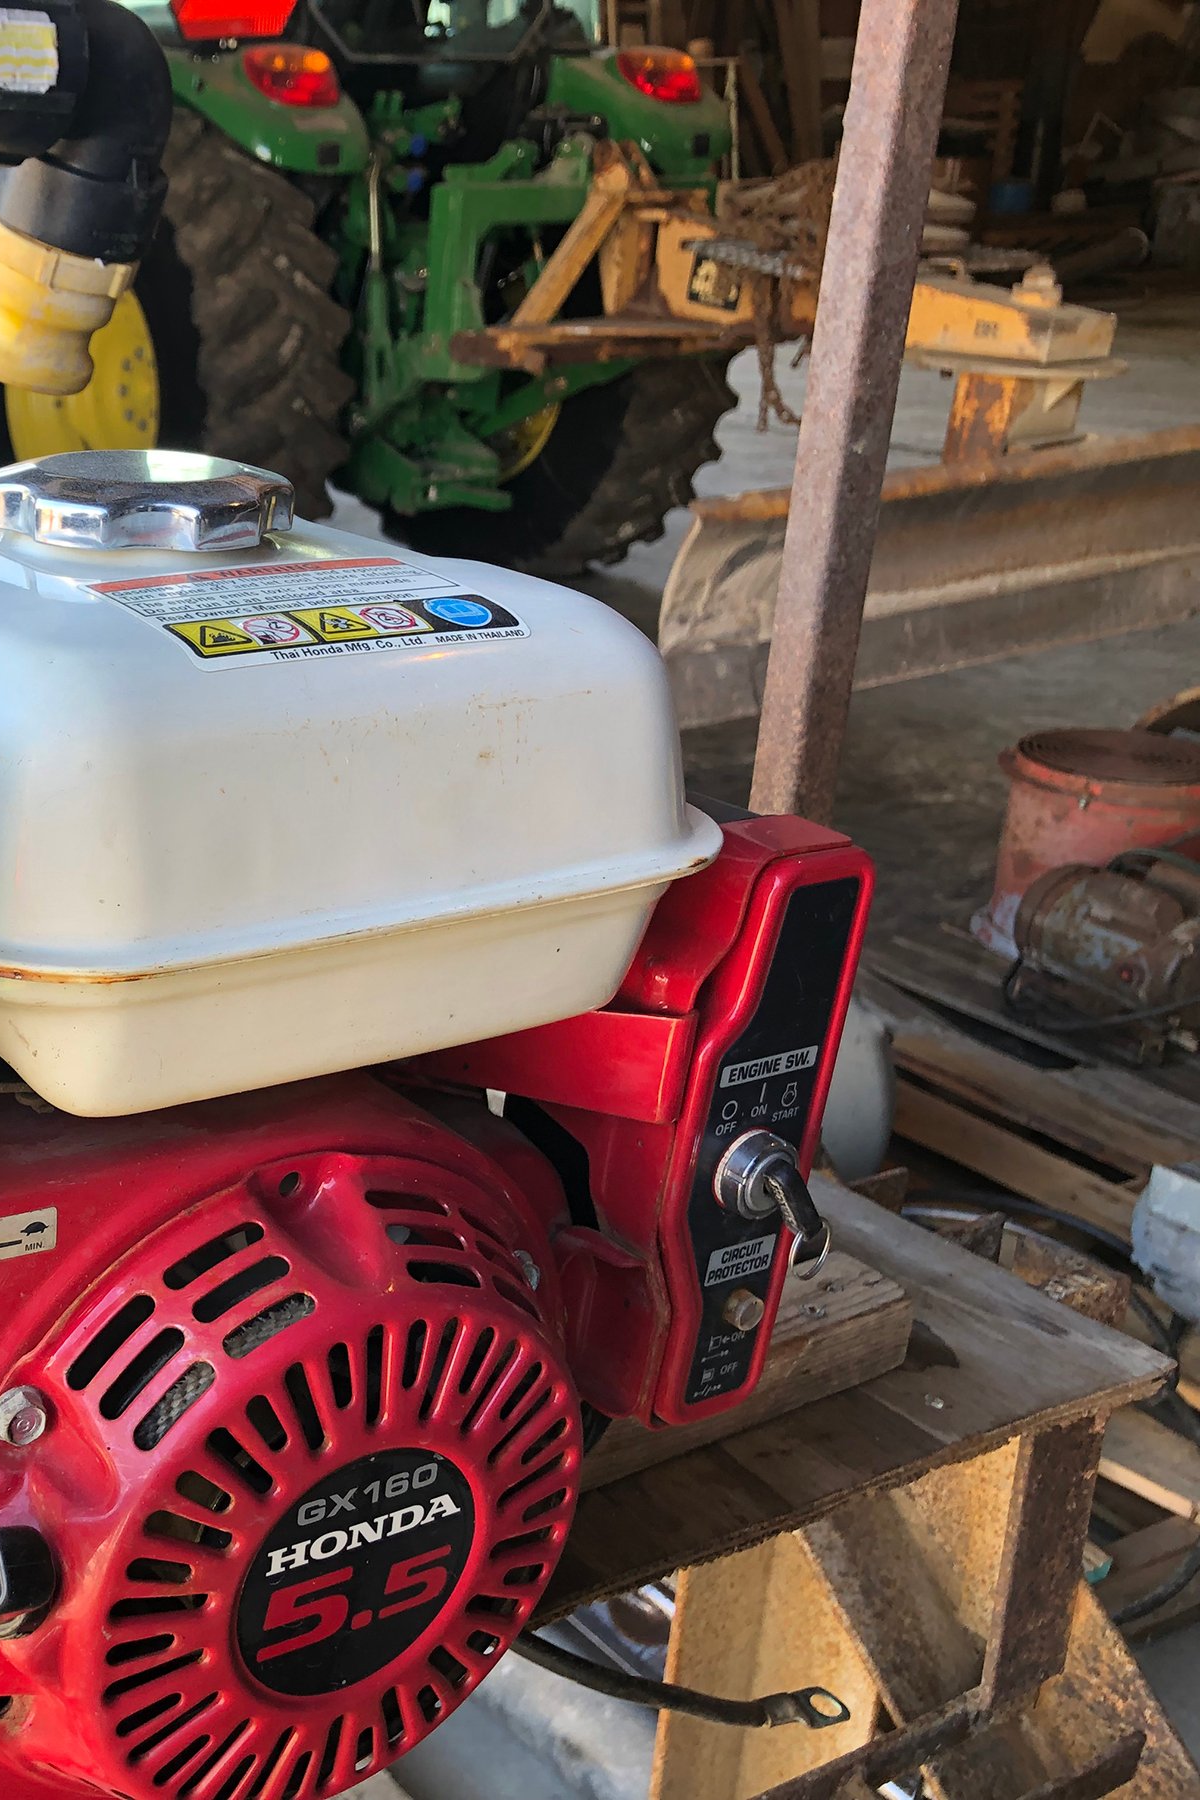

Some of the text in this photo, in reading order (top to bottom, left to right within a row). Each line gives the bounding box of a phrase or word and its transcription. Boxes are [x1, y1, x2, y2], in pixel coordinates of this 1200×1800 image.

[218, 563, 321, 578] WARNING
[167, 595, 216, 605] engine
[219, 590, 260, 599] emits
[260, 586, 296, 595] toxic
[298, 583, 346, 591] carbon
[169, 604, 194, 612] not
[196, 601, 222, 609] run
[264, 589, 326, 601] enclosed
[156, 613, 195, 623] Read
[195, 607, 253, 619] Owner's
[252, 600, 305, 612] Manual
[305, 597, 351, 607] before
[435, 629, 525, 643] MADE IN THAILAND
[270, 636, 427, 661] Thai Honda Mfg. Co., Ltd.
[727, 1050, 810, 1083] ENGINE SW.
[751, 1104, 768, 1118] ON
[771, 1106, 800, 1122] START
[715, 1121, 737, 1136] OFF
[24, 1240, 45, 1252] MIN.
[721, 1243, 764, 1264] CIRCUIT
[707, 1255, 769, 1285] PROTECTOR
[731, 1331, 746, 1342] ON
[720, 1362, 738, 1375] OFF
[265, 1493, 461, 1577] HONDA
[256, 1544, 451, 1663] 5.5
